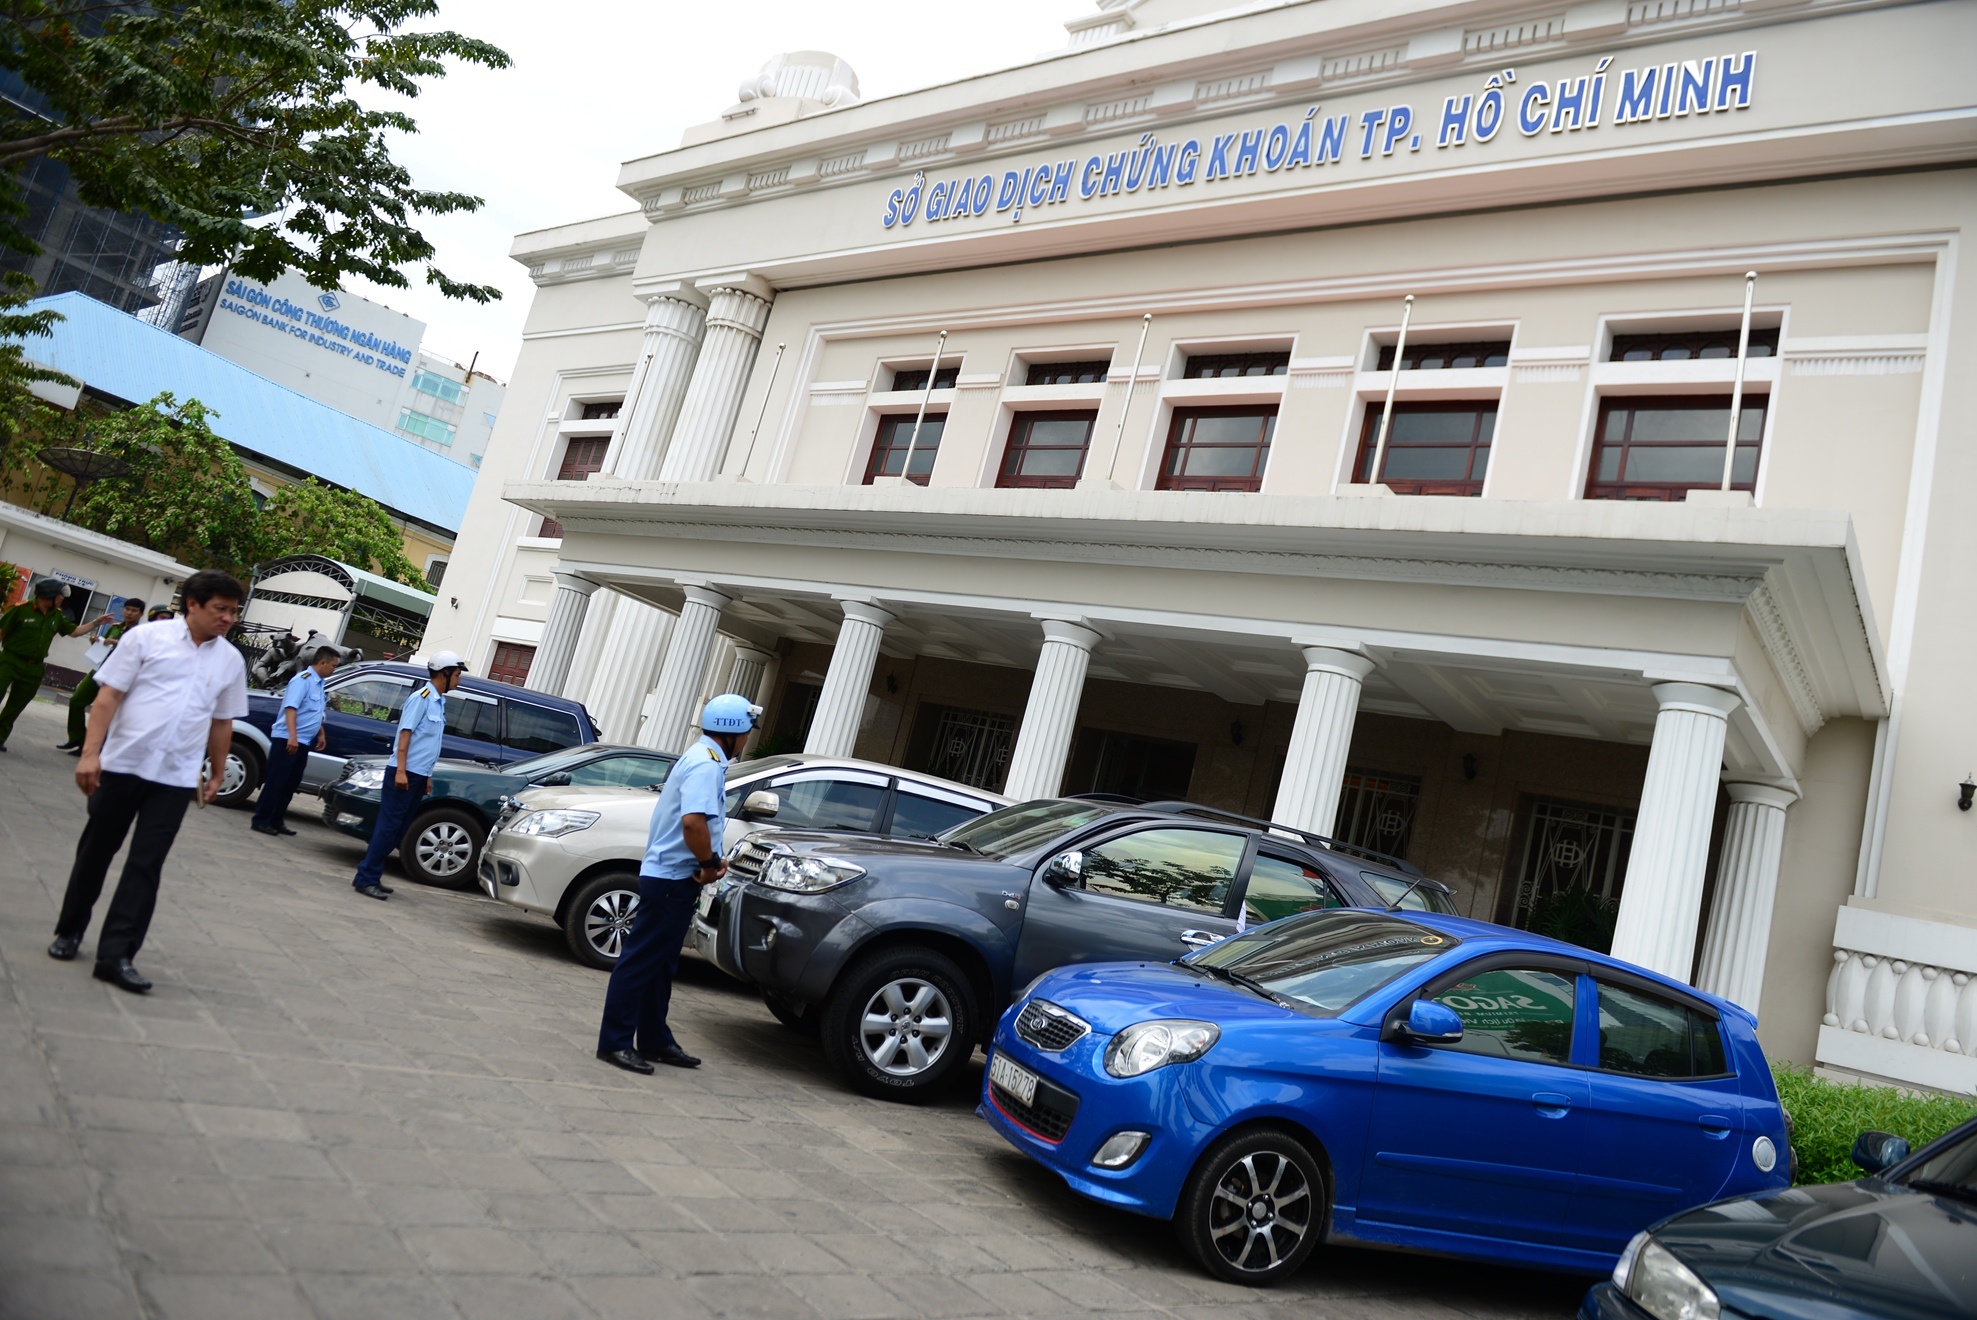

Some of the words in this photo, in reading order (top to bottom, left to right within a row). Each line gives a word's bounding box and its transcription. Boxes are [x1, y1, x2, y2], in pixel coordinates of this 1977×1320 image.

[882, 170, 925, 228] SỞ
[924, 174, 994, 222] GIAO
[996, 159, 1076, 221] DỊCH
[1079, 133, 1201, 200] CHỨNG
[1205, 105, 1350, 181] KHOÁN
[1358, 104, 1423, 159] TP.
[1435, 68, 1516, 148] HỒ
[1516, 55, 1615, 137] CHÍ
[1612, 50, 1757, 125] MINH
[220, 298, 262, 322] SAIGON
[261, 314, 289, 333] BANK
[289, 325, 308, 341] FOR
[308, 332, 353, 357] INDUSTRY
[353, 350, 374, 366] AND
[376, 358, 406, 378] TRADE
[226, 280, 248, 299] SÀI
[246, 288, 272, 309] GÒN
[272, 298, 304, 322] CÔNG
[305, 310, 350, 340] THƯƠNG
[350, 329, 382, 352] NGÂN
[381, 341, 412, 364] HÀNG
[867, 1067, 915, 1087] TOYO
